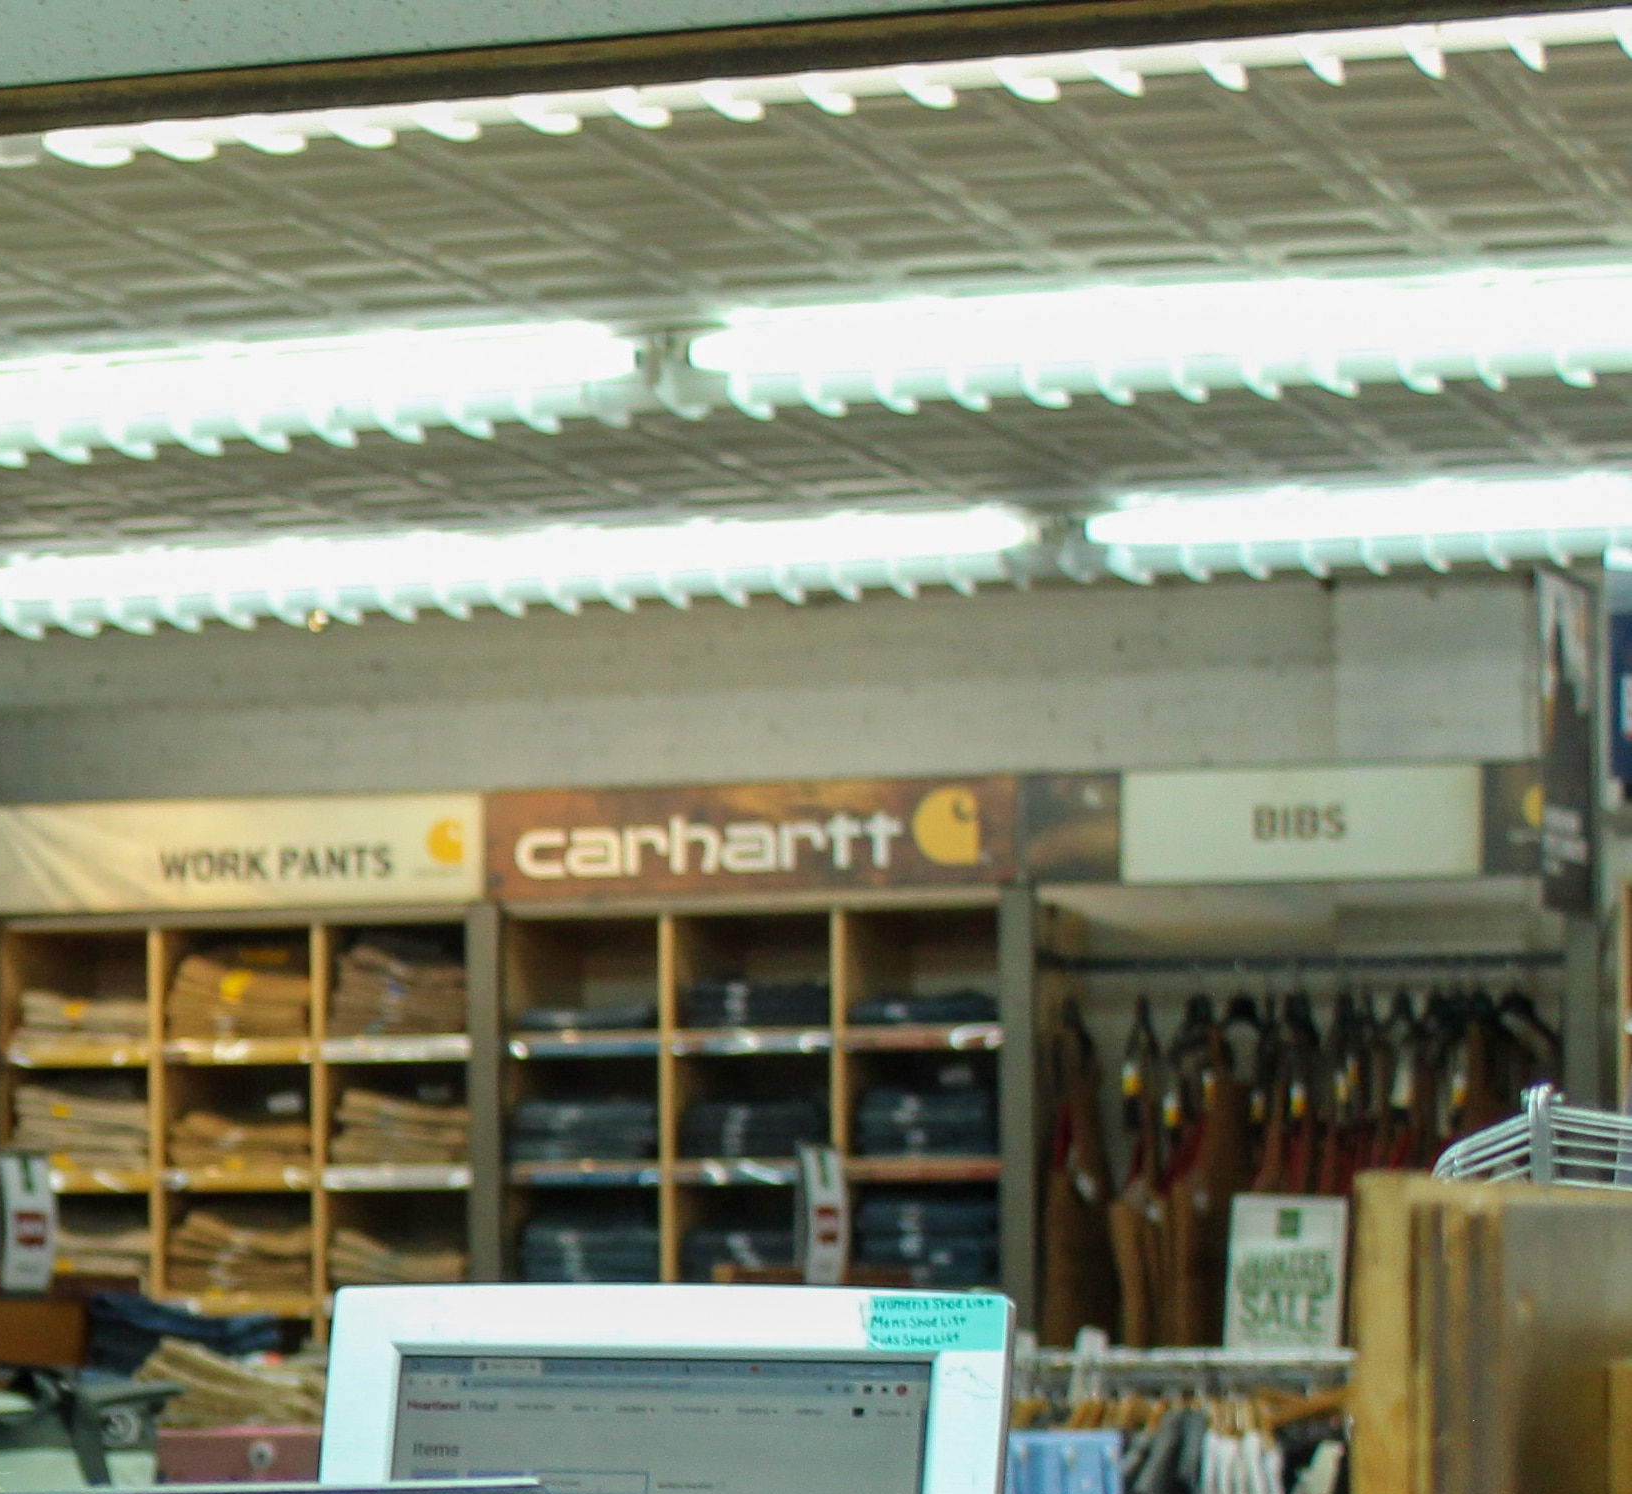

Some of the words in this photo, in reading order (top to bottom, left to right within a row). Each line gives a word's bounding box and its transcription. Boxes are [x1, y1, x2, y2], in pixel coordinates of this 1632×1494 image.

[1252, 804, 1347, 840] BIBS
[160, 848, 268, 881] WORK
[279, 843, 396, 879] PANTS
[514, 811, 903, 880] carhartt
